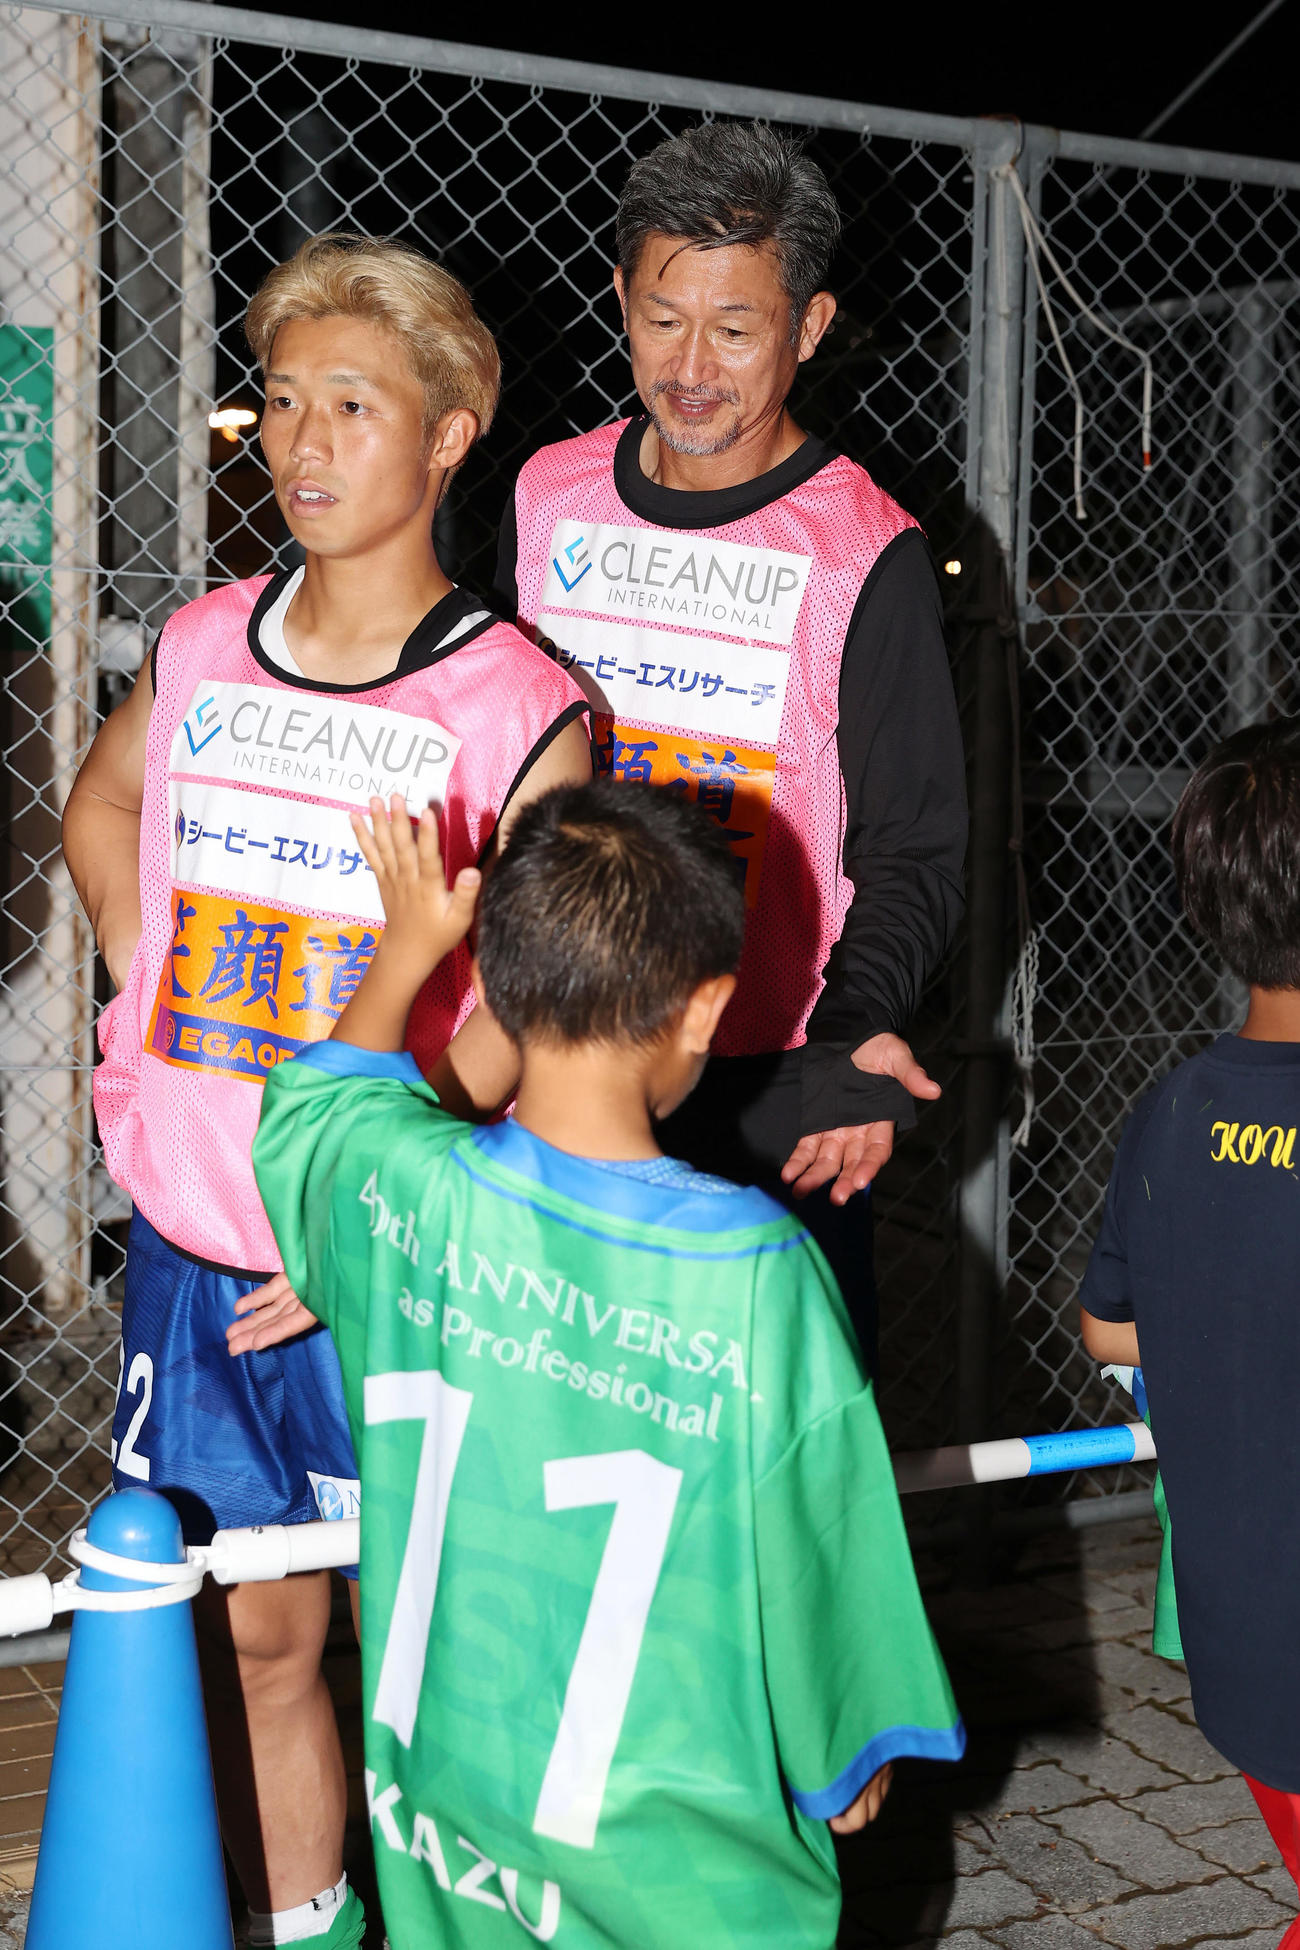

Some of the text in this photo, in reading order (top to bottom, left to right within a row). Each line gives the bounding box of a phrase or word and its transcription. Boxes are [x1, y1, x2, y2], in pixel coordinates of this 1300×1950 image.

[600, 541, 799, 608] CLEANUP
[606, 587, 773, 630] INTERNATIONAL
[229, 700, 449, 778] CLEANUP
[398, 1286, 434, 1327] as
[435, 1239, 763, 1402] ANNIVERSA
[364, 1767, 562, 1942] KAZU
